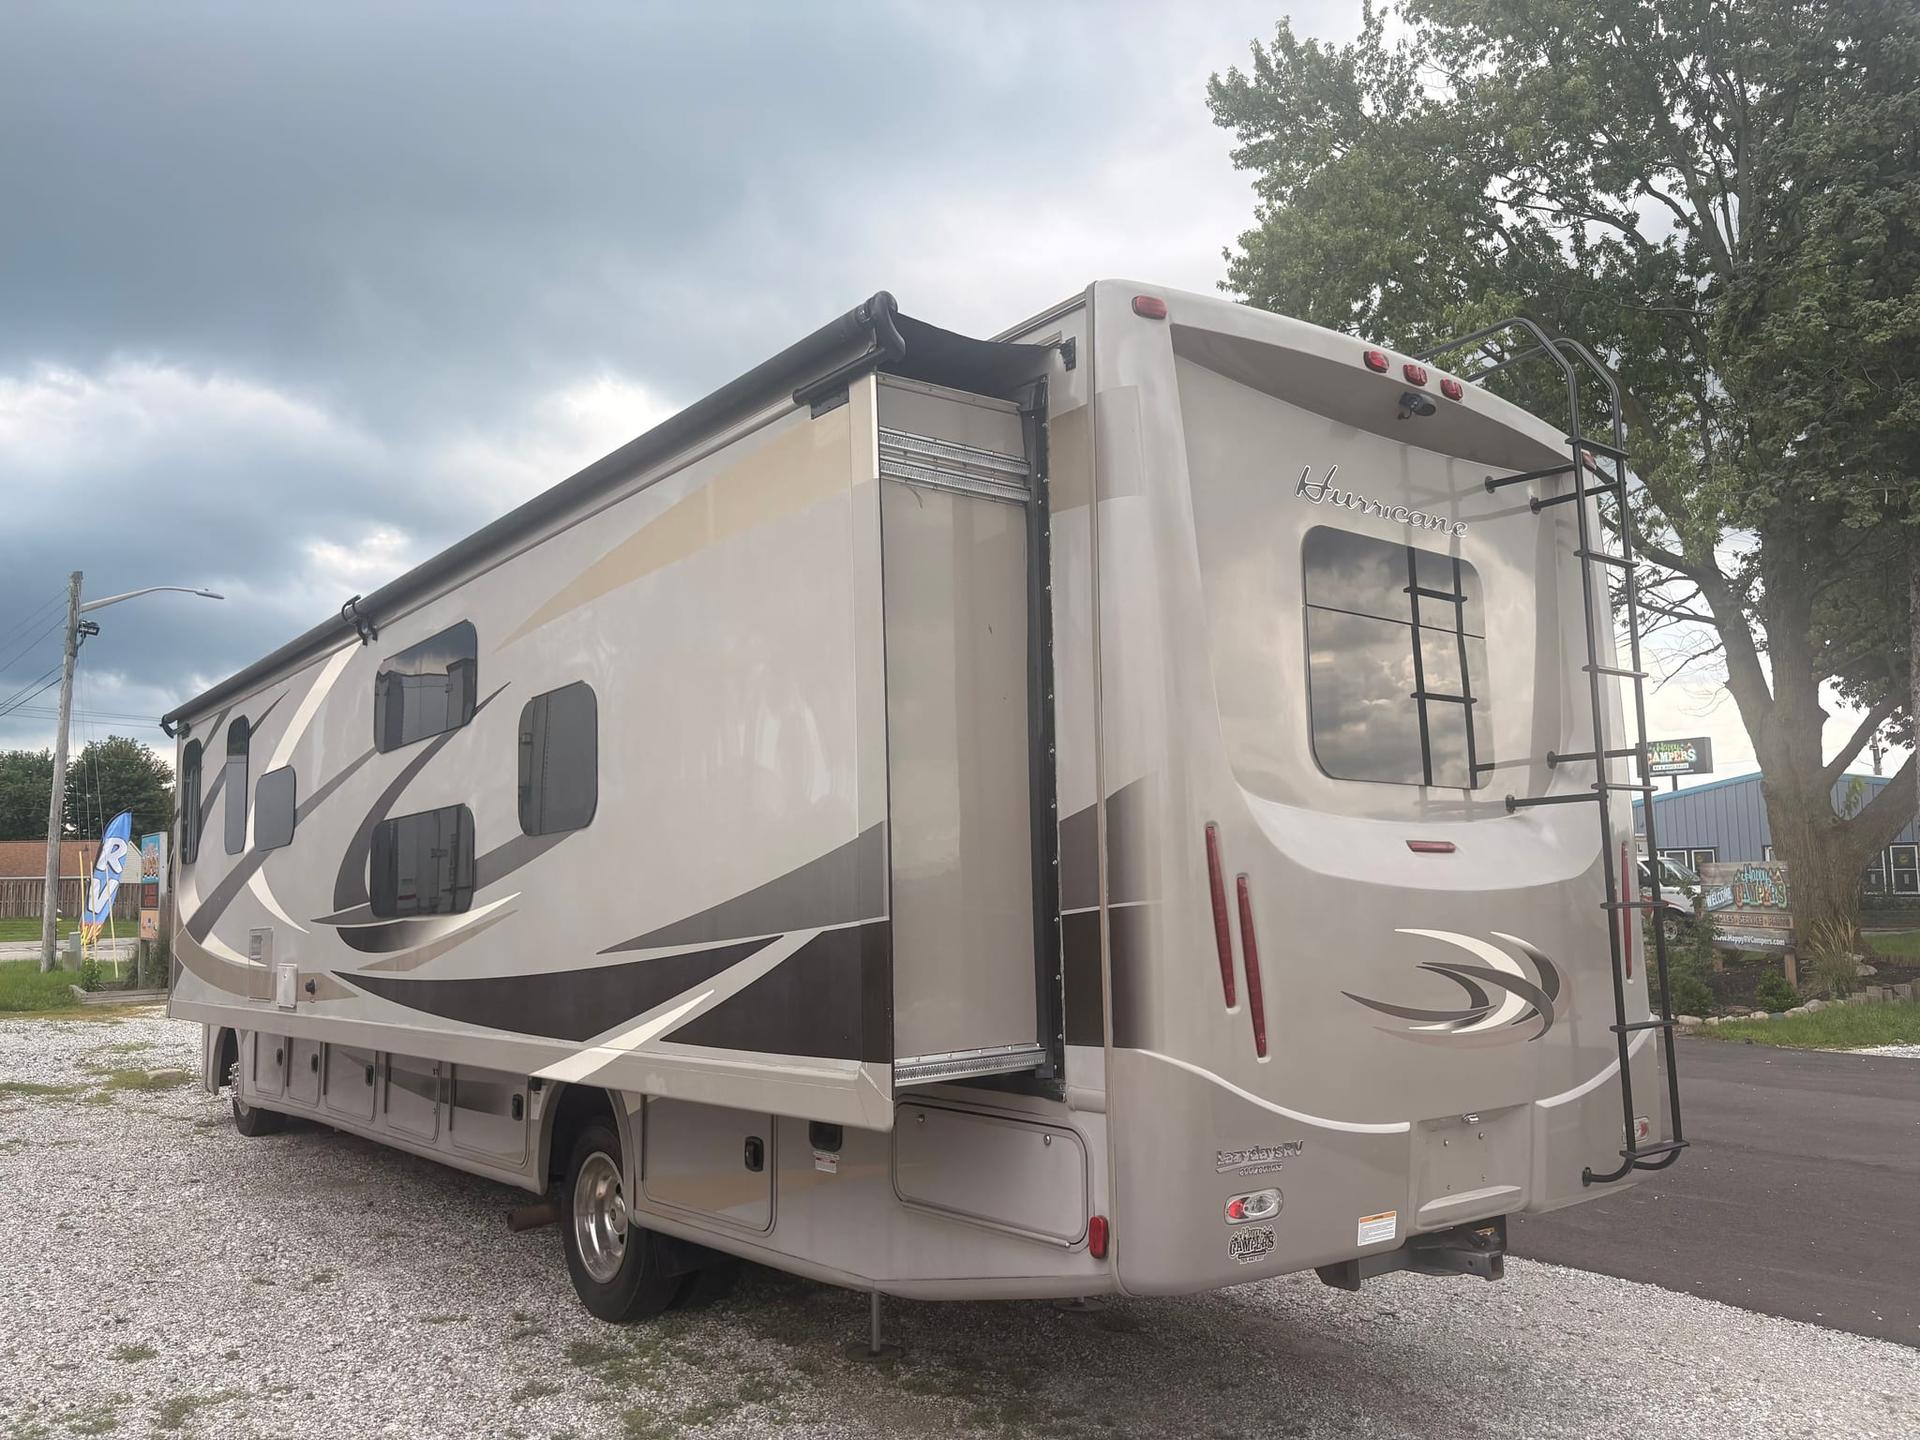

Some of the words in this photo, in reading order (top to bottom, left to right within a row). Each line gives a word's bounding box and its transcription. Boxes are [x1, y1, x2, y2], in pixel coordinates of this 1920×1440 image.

[1295, 464, 1469, 538] Hurricane
[88, 838, 127, 914] RV
[1734, 880, 1787, 909] CAMPERS
[1741, 863, 1771, 886] Happy
